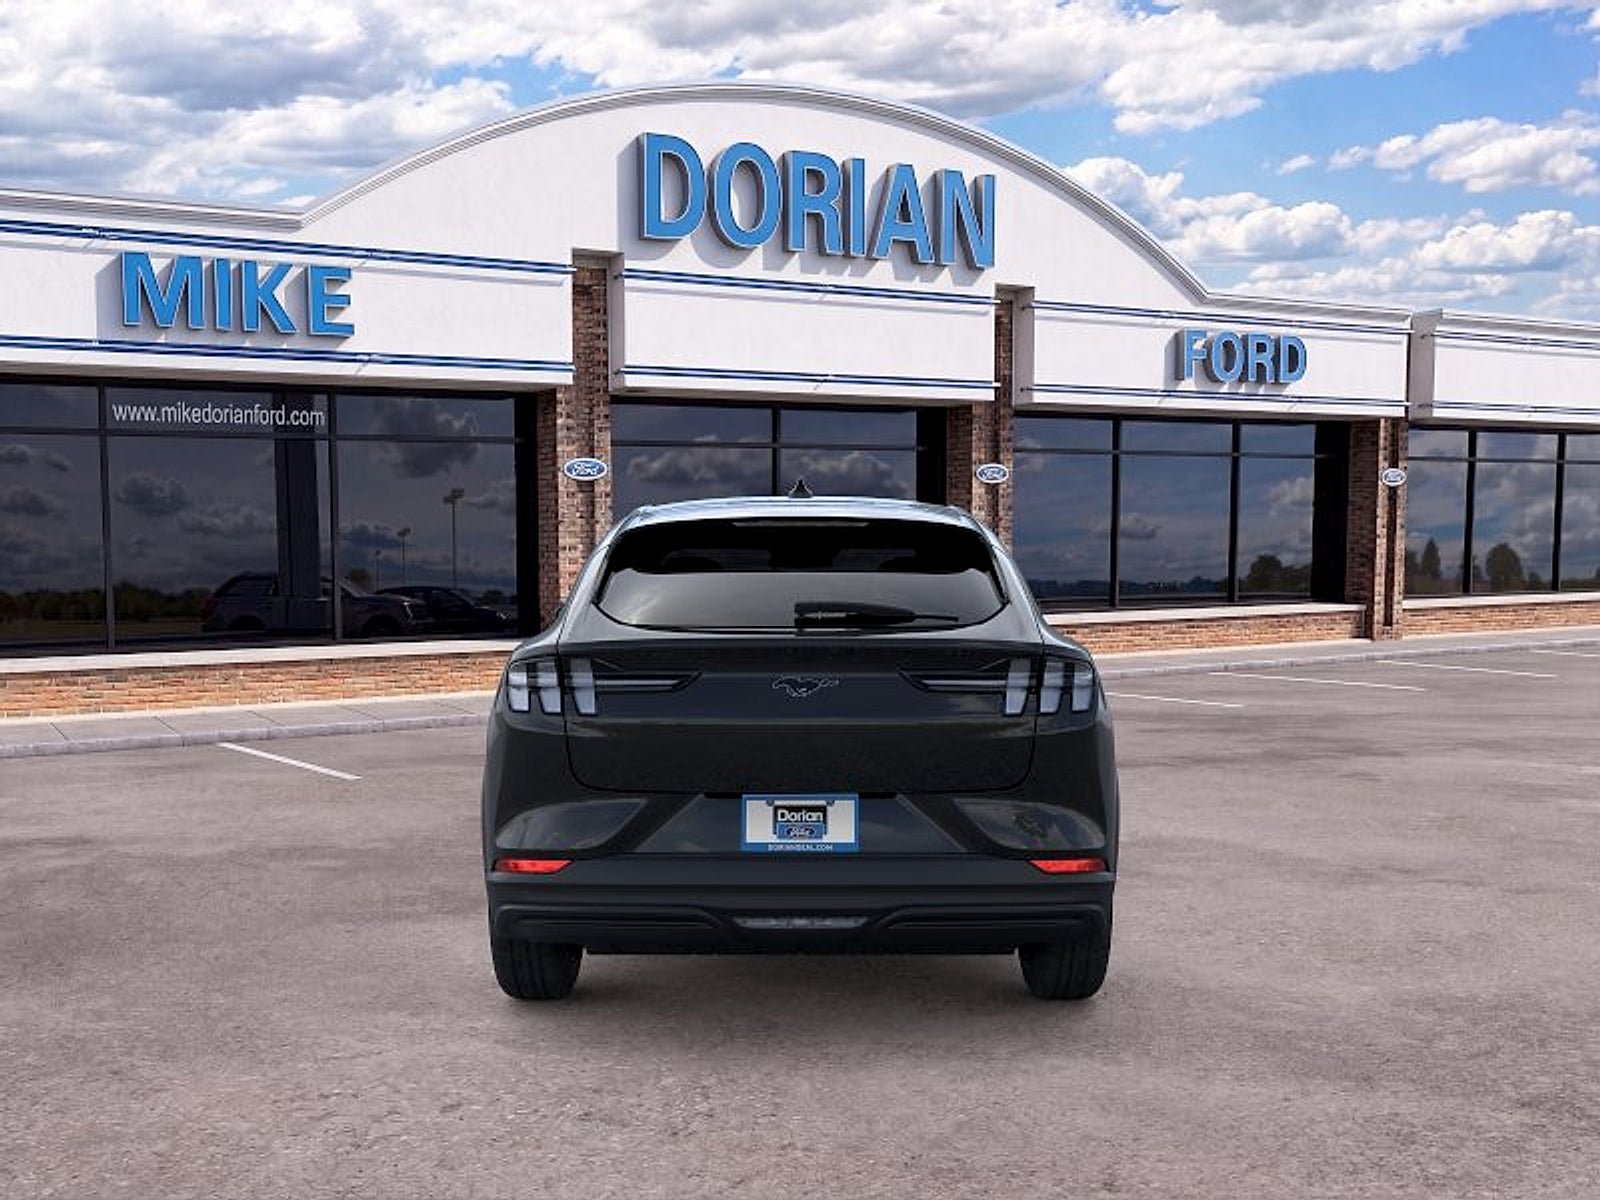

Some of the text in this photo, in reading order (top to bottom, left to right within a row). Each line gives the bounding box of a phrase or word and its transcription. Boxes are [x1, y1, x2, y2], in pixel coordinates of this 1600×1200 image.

[640, 132, 996, 270] DORIAN
[120, 251, 355, 338] MIKE
[1176, 328, 1308, 384] FORD
[112, 401, 326, 427] www.mikedorianford.com
[777, 809, 823, 822] Dorian
